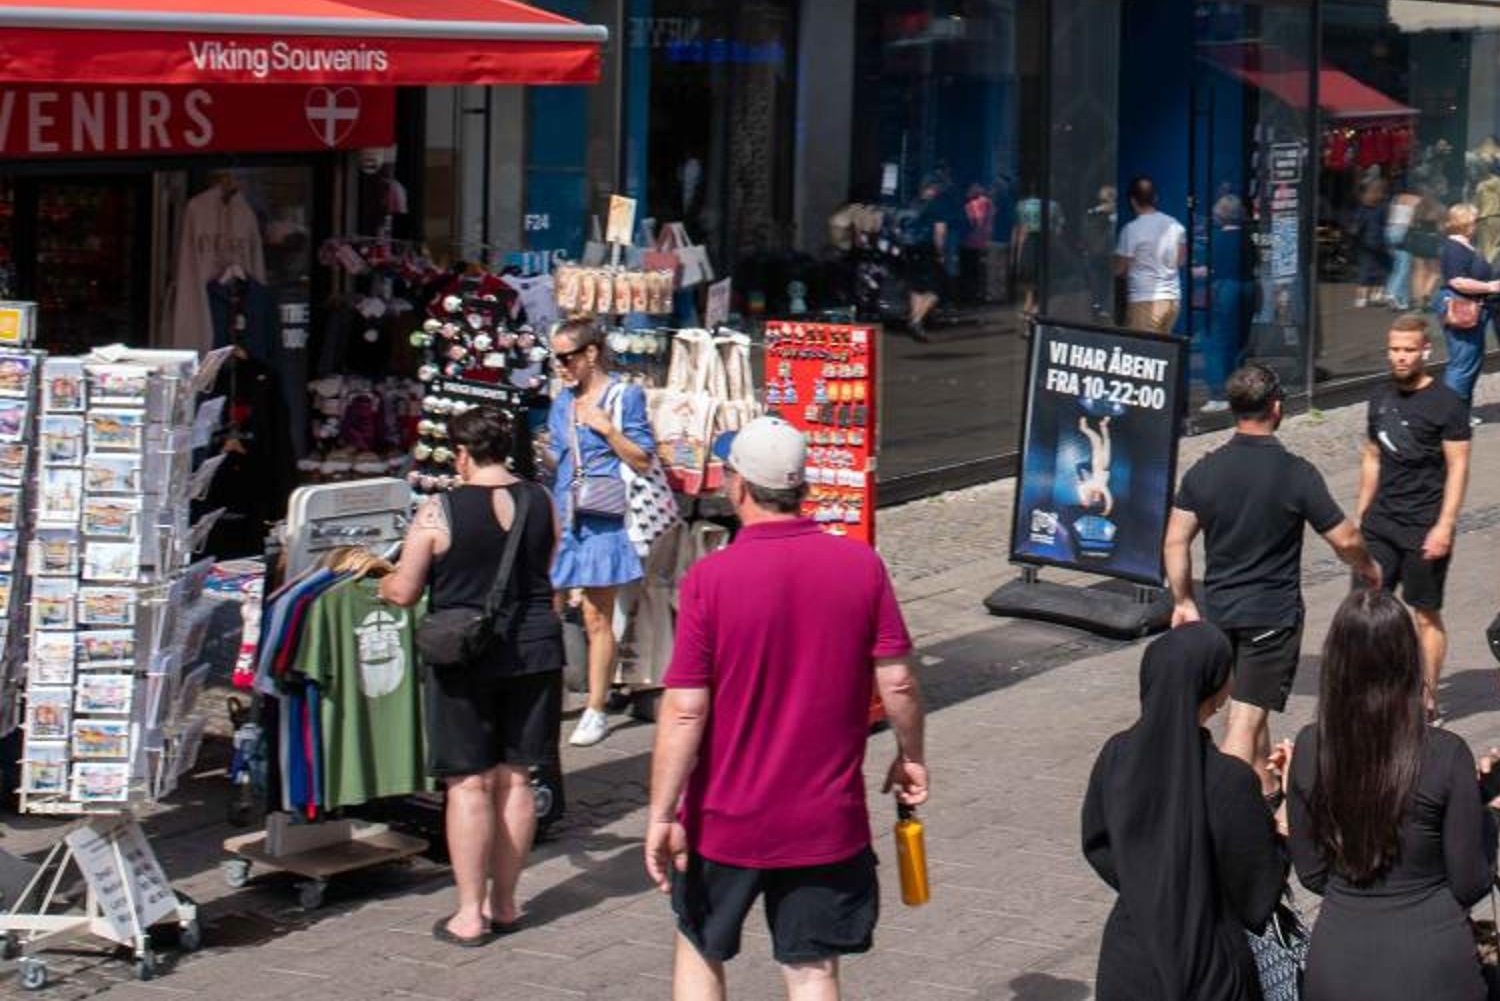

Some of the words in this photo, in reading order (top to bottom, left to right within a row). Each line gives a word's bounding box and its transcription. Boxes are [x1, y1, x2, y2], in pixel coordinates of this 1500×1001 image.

[188, 40, 269, 78] Viking
[271, 39, 389, 73] Souvenirs
[1048, 340, 1071, 366] VI
[1070, 343, 1107, 373] HAR
[1107, 346, 1169, 382] ÅBENT
[1045, 368, 1080, 396] FRA
[1081, 374, 1166, 410] 10-22:00
